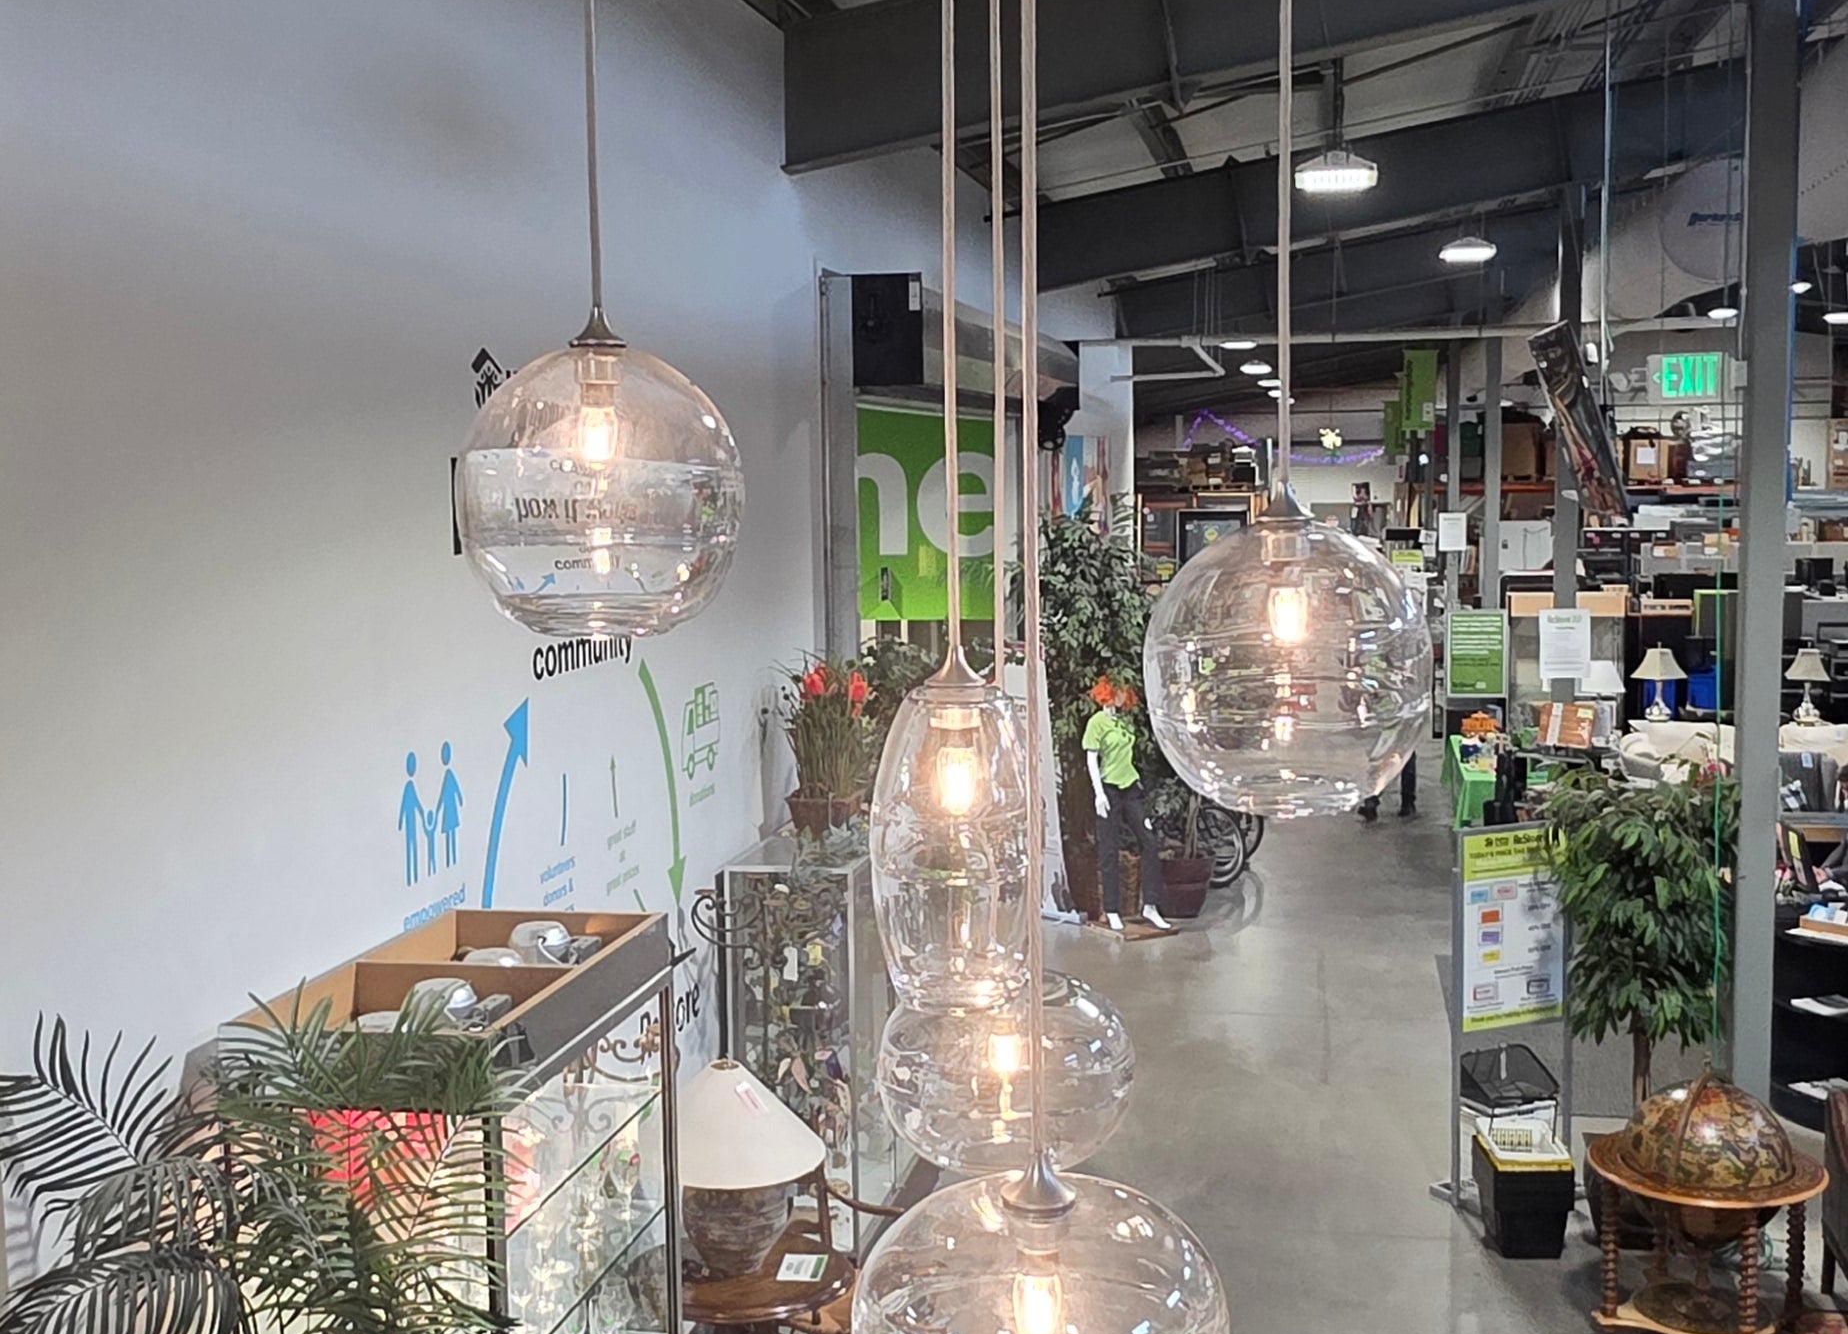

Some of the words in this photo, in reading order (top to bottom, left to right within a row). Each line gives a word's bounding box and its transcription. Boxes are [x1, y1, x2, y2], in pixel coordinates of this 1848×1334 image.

[1662, 356, 1718, 398] EXIT
[533, 634, 632, 680] community
[403, 882, 466, 933] empowered
